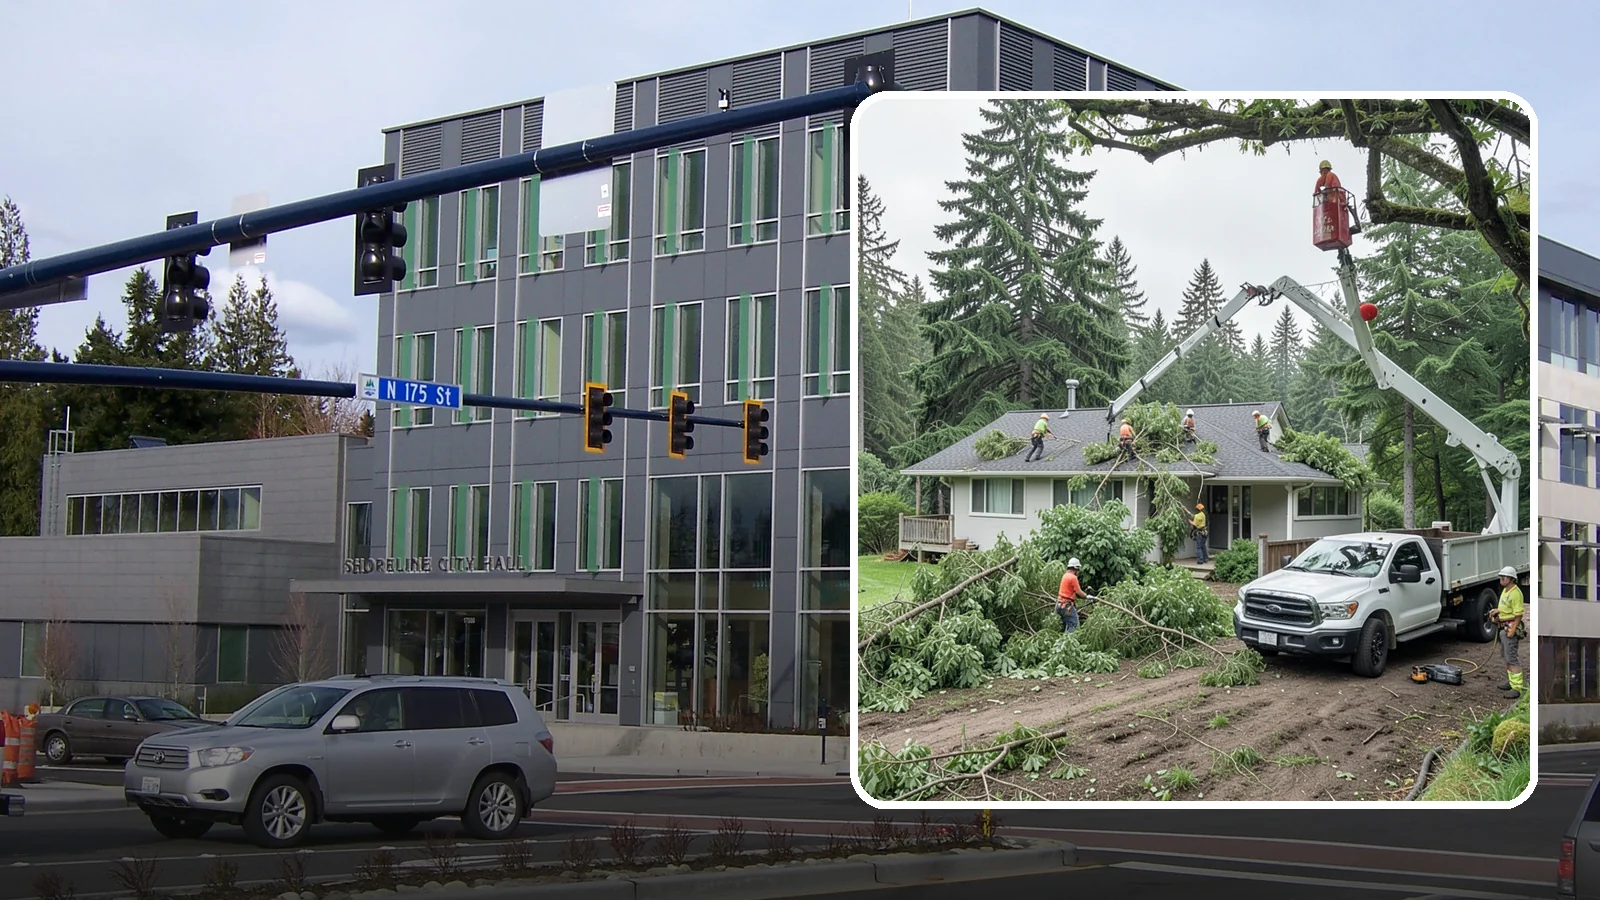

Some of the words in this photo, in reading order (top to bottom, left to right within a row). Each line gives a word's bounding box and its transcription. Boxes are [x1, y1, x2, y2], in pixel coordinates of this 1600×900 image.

[387, 380, 396, 400] N
[405, 382, 428, 403] 175
[436, 386, 451, 406] St
[344, 558, 432, 574] SHORELINE
[438, 557, 475, 572] CITY
[483, 556, 526, 571] HALL
